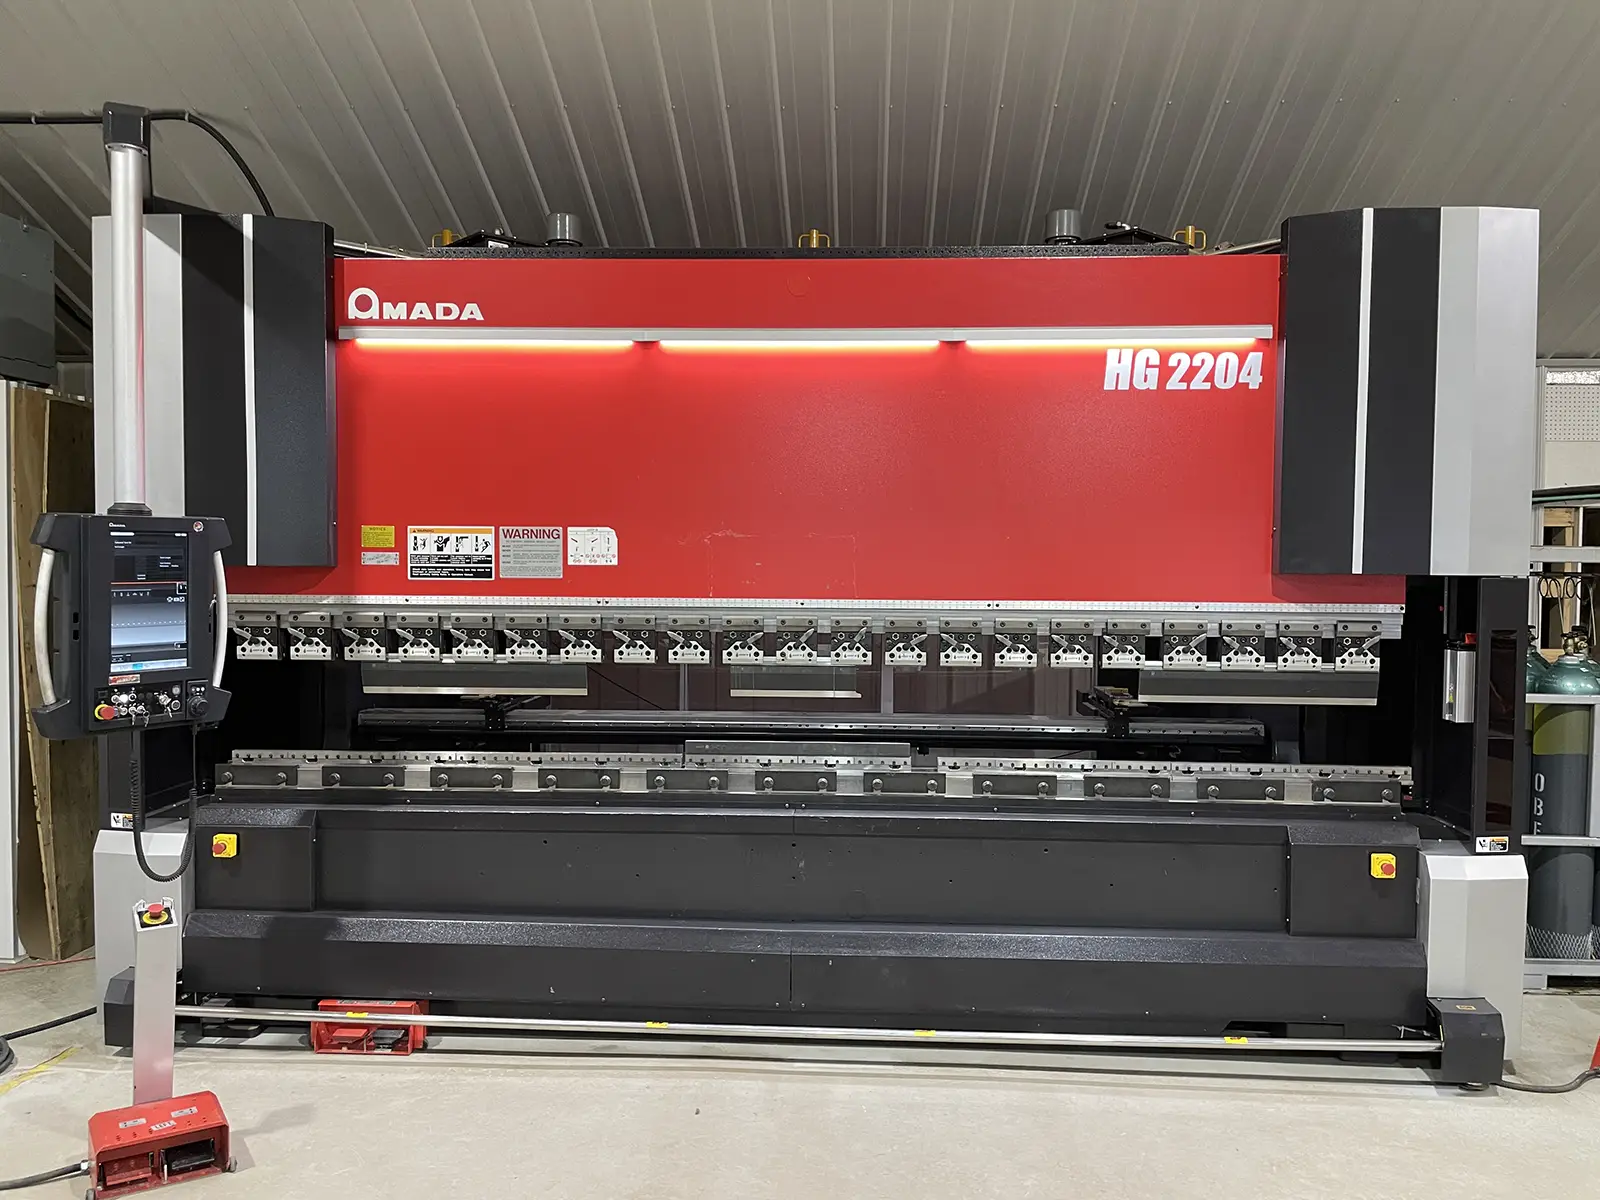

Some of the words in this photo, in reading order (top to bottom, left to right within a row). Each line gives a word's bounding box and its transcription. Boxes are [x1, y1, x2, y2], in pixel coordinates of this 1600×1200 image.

[348, 287, 484, 320] AMADA
[1103, 348, 1161, 391] HG
[1166, 352, 1264, 390] 2204
[502, 529, 561, 540] WARNING
